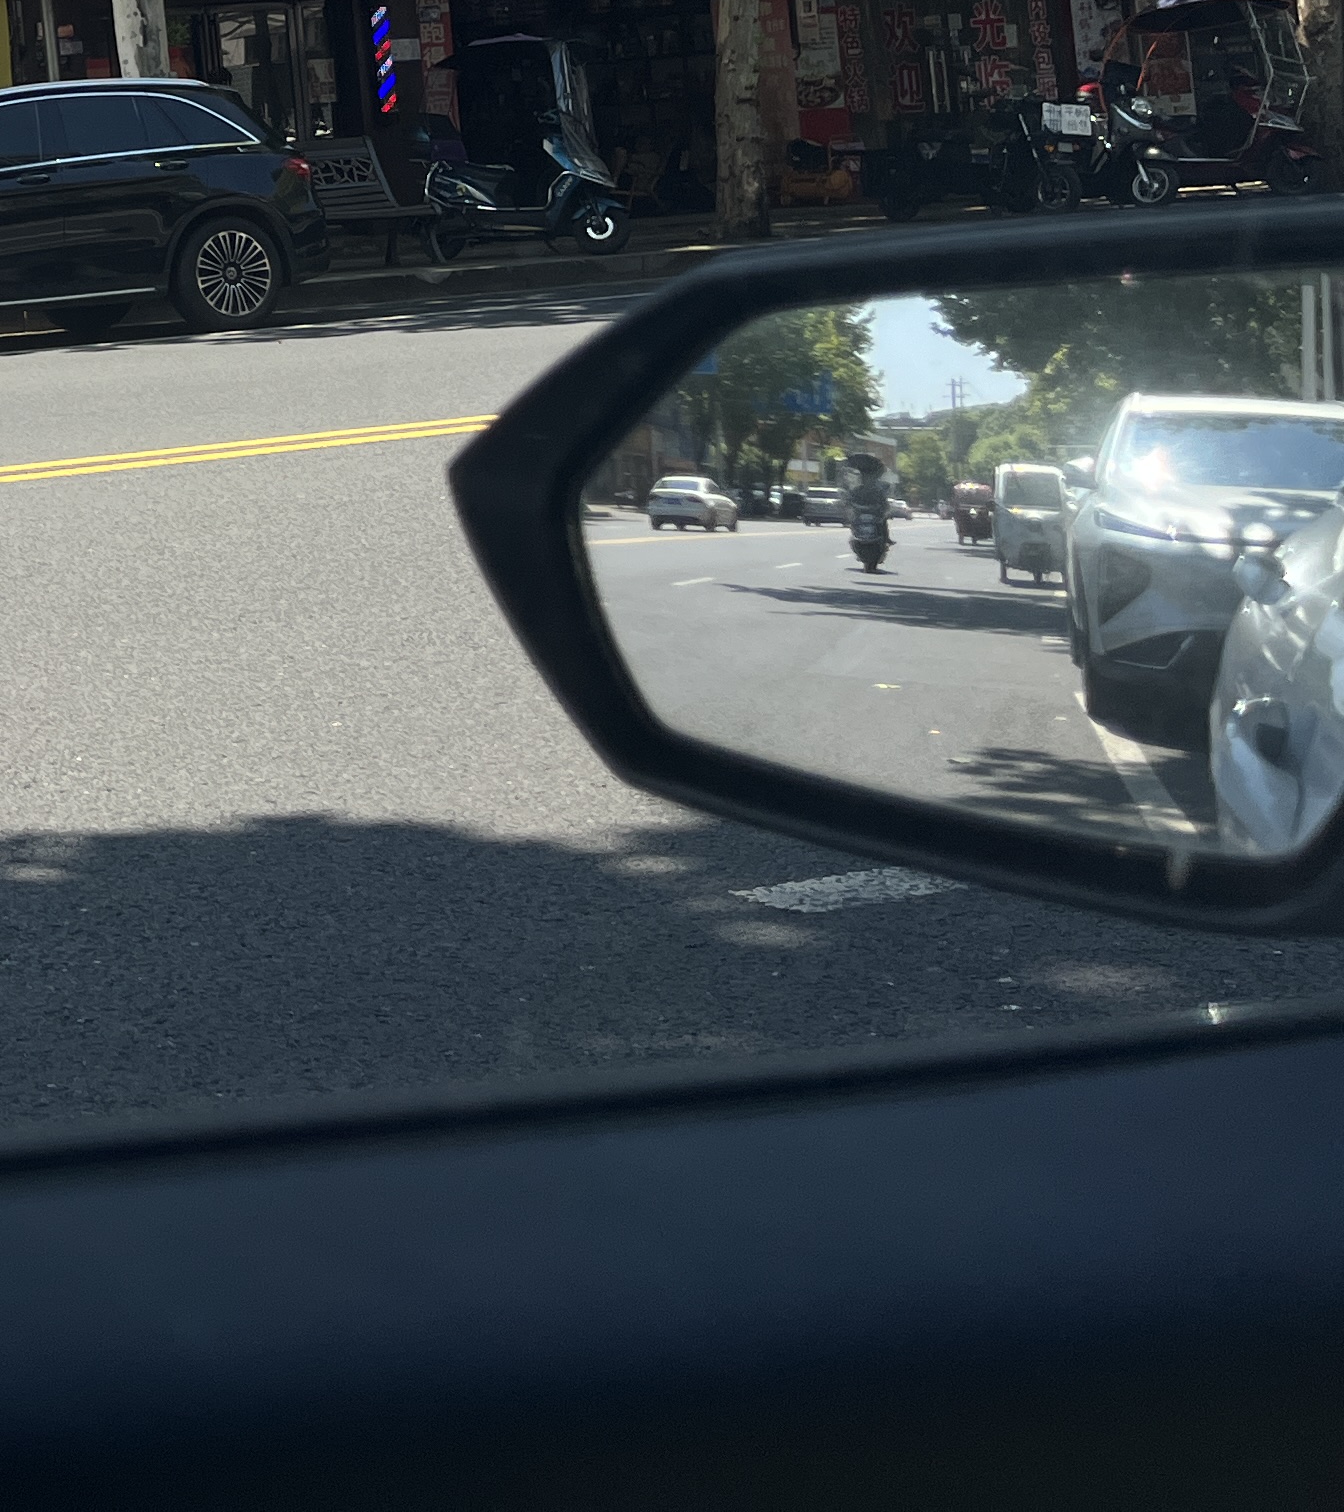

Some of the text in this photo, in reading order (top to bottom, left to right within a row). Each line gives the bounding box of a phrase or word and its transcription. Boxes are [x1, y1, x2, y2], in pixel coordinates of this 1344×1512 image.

[836, 4, 870, 114] 特色火锅
[883, 1, 928, 114] 欢迎
